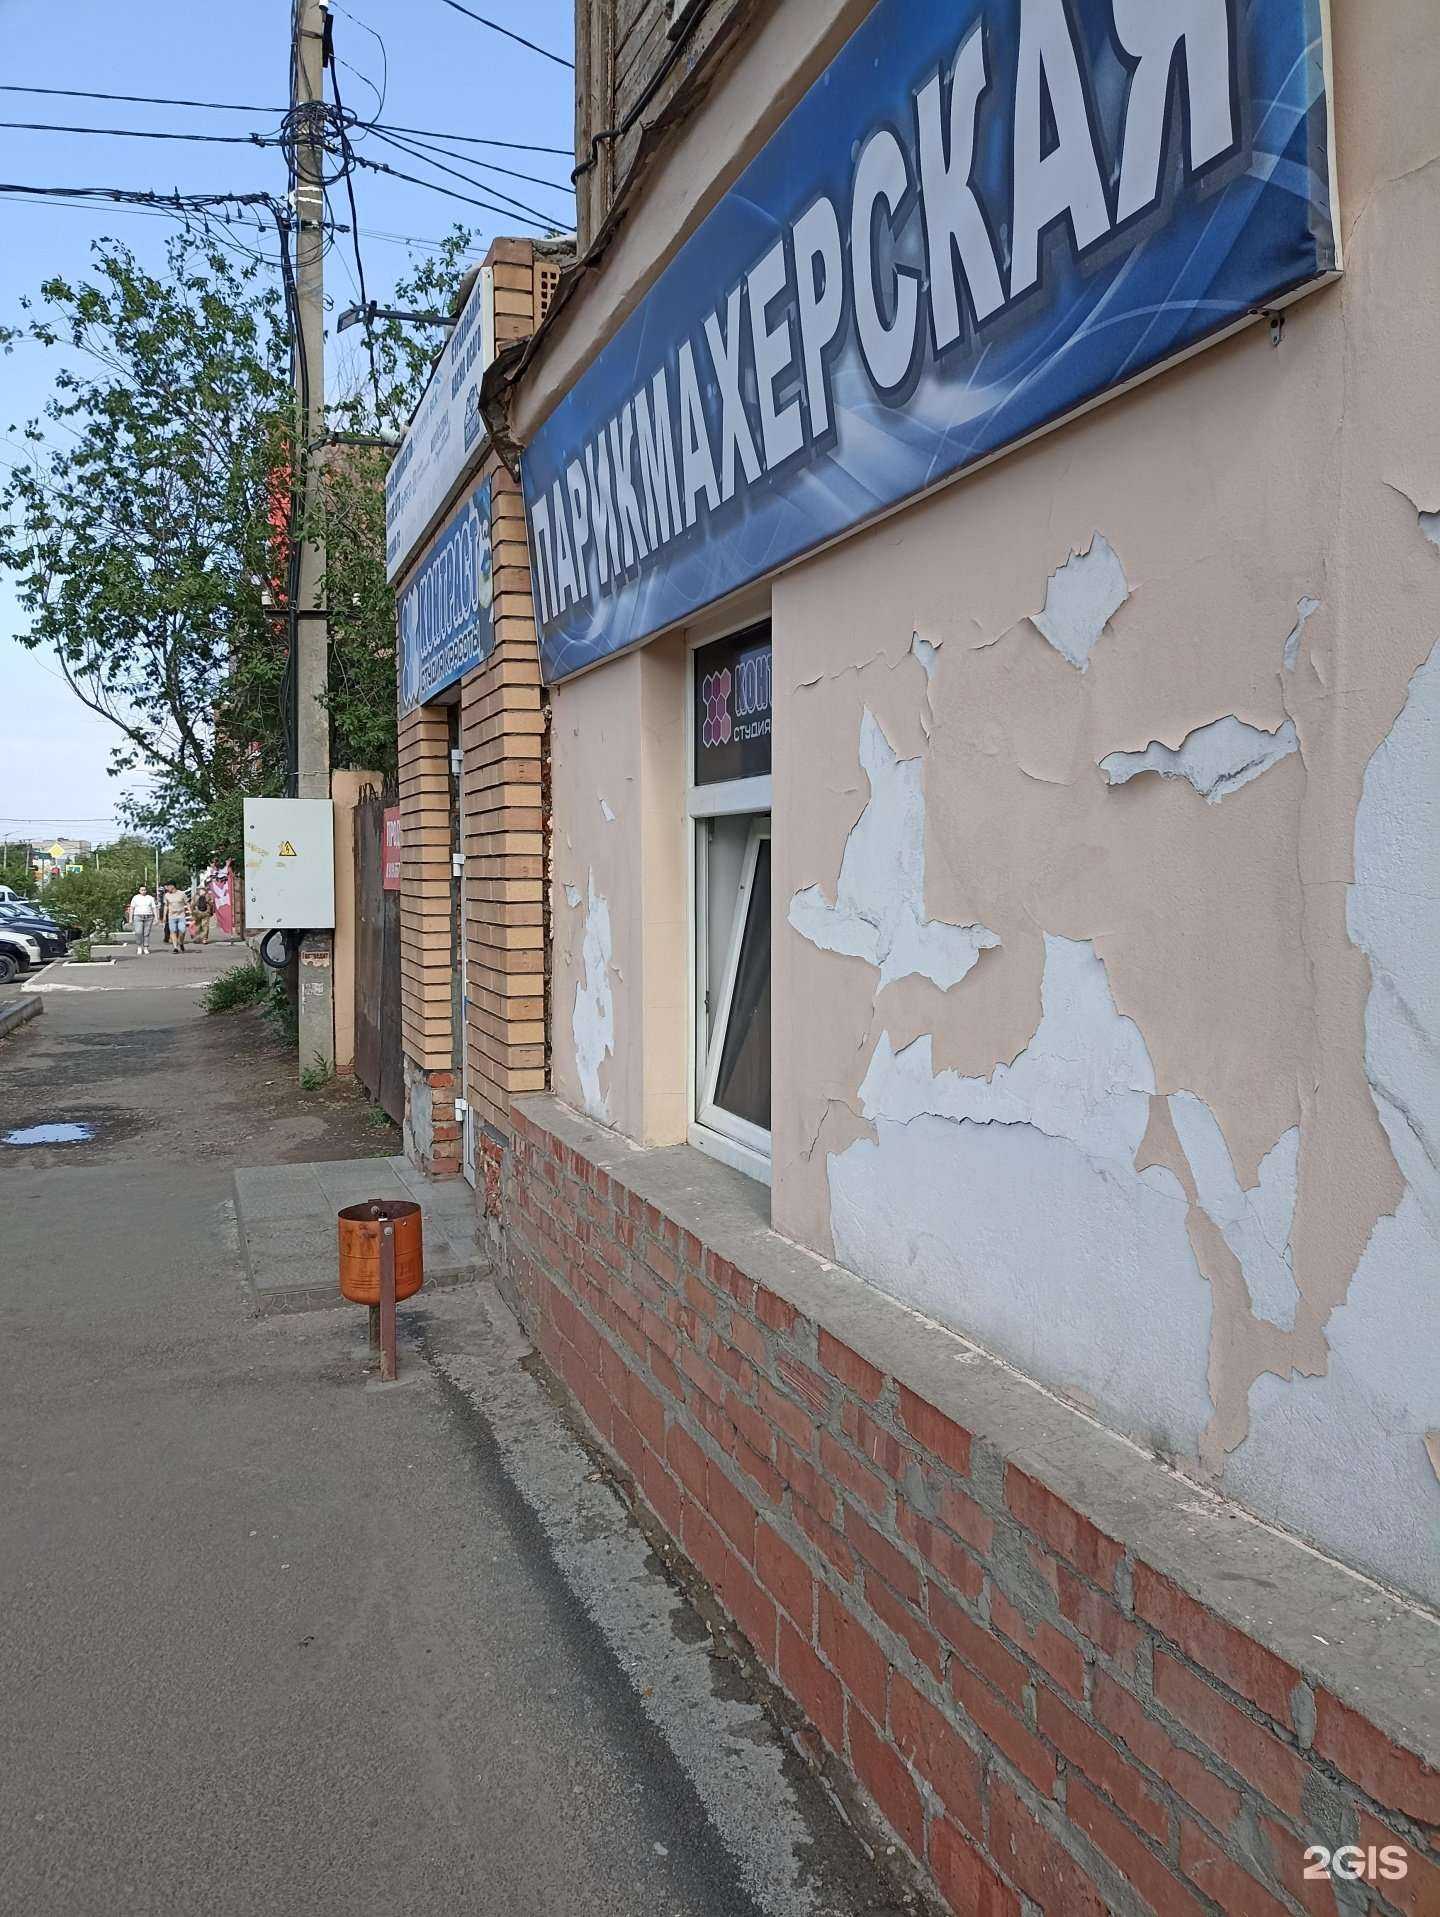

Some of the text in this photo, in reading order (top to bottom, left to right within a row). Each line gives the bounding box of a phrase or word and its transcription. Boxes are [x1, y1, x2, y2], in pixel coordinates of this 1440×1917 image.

[531, 0, 1235, 626] ПАРИКМАХЕРСКАЯ
[419, 507, 480, 657] КОНТРАСТ
[421, 620, 480, 692] СТУДИЯ КРАСОТЫ
[733, 718, 771, 742] СТУДИЯ
